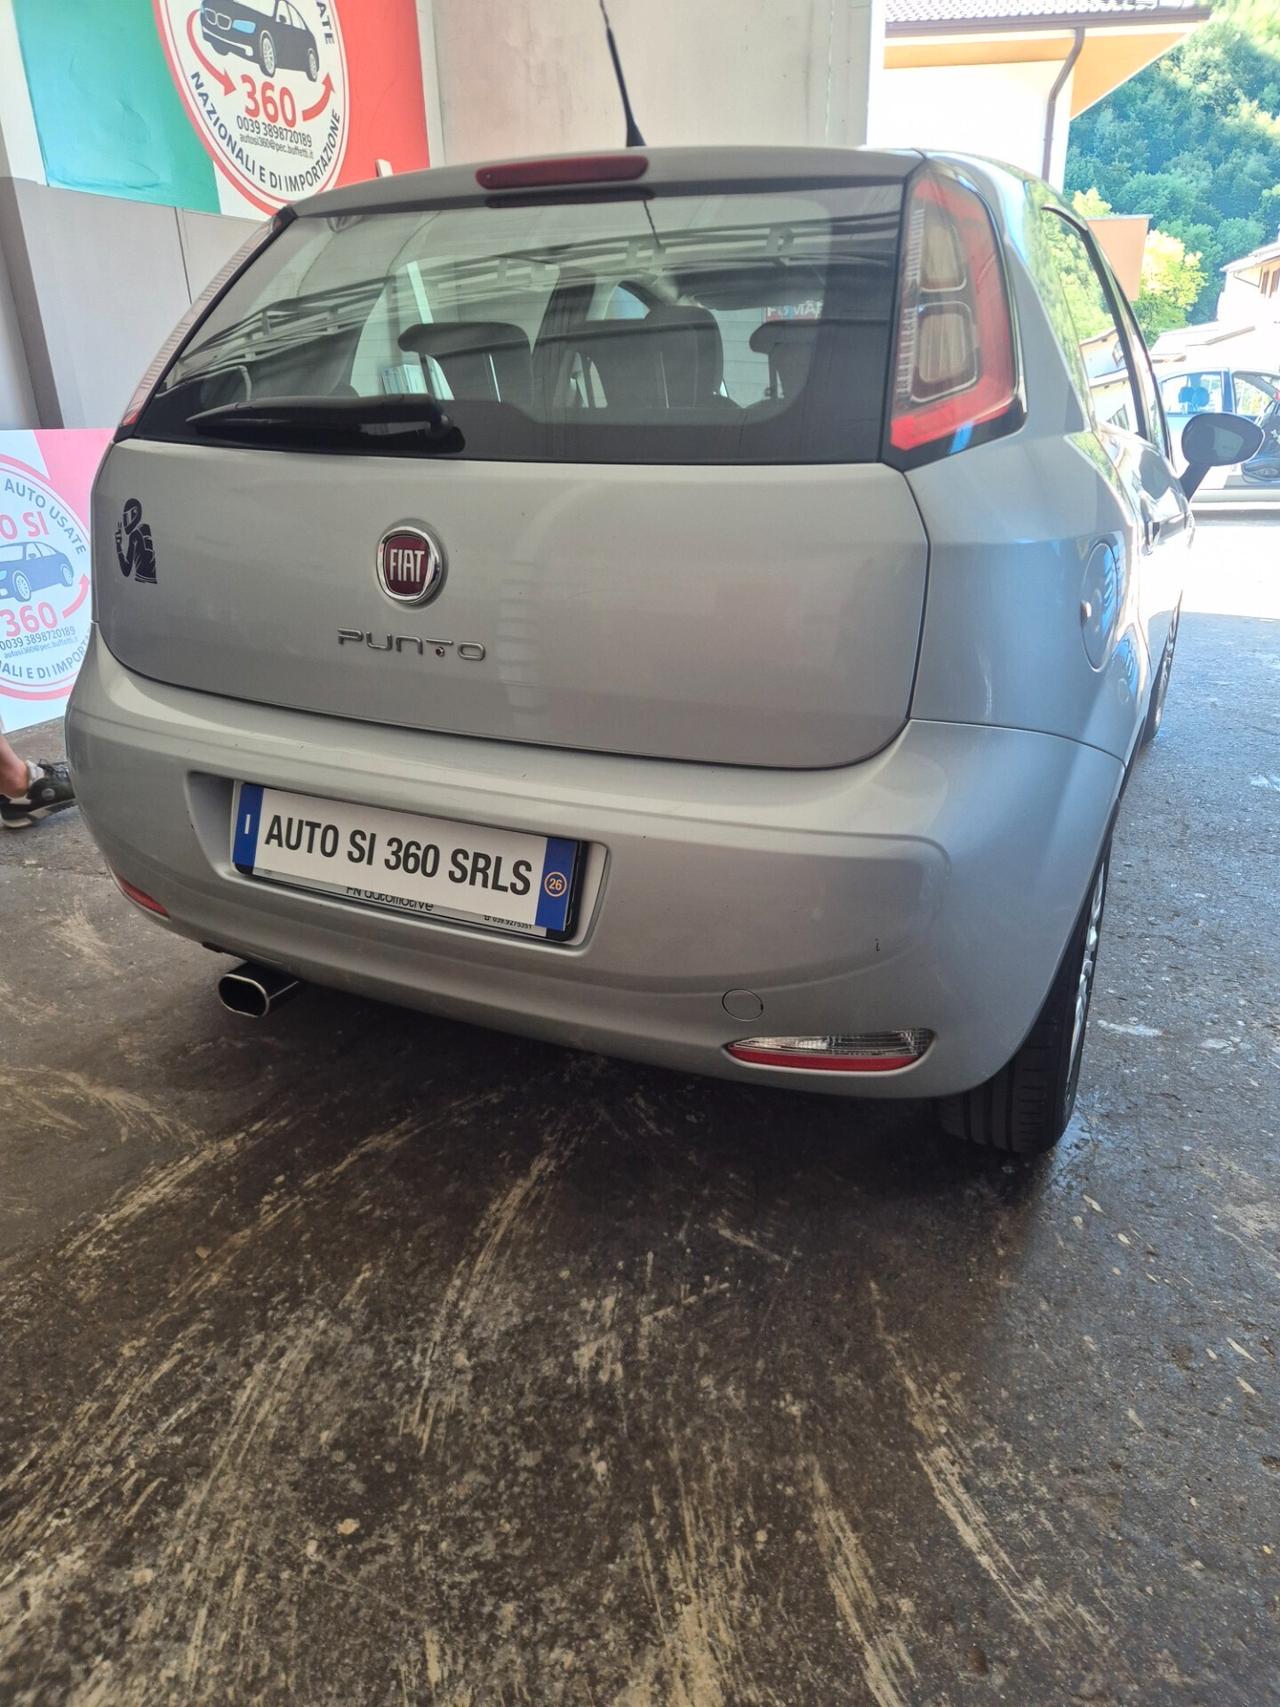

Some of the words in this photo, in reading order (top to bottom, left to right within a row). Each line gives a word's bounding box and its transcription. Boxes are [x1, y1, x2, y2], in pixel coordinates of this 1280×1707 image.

[240, 74, 297, 128] 360
[190, 71, 255, 175] NAZIONALI
[259, 165, 266, 184] E
[269, 174, 282, 191] DI
[286, 109, 341, 192] IMPORTAZIONE
[236, 115, 261, 134] 0039
[261, 122, 313, 148] 3898720189
[4, 478, 46, 508] AUTO
[49, 506, 87, 554] USATE
[23, 511, 49, 537] SI
[389, 549, 425, 583] FIAT
[0, 601, 57, 637] 360
[0, 637, 23, 651] 0039
[24, 626, 76, 645] 3898720189
[337, 627, 487, 662] PUNTO
[26, 667, 34, 679] E
[36, 667, 51, 679] DI
[244, 814, 251, 835] I
[264, 814, 340, 858] AUTO
[347, 829, 377, 866] SI
[384, 837, 440, 878] 360
[448, 848, 533, 896] SRLS
[548, 878, 562, 891] 26
